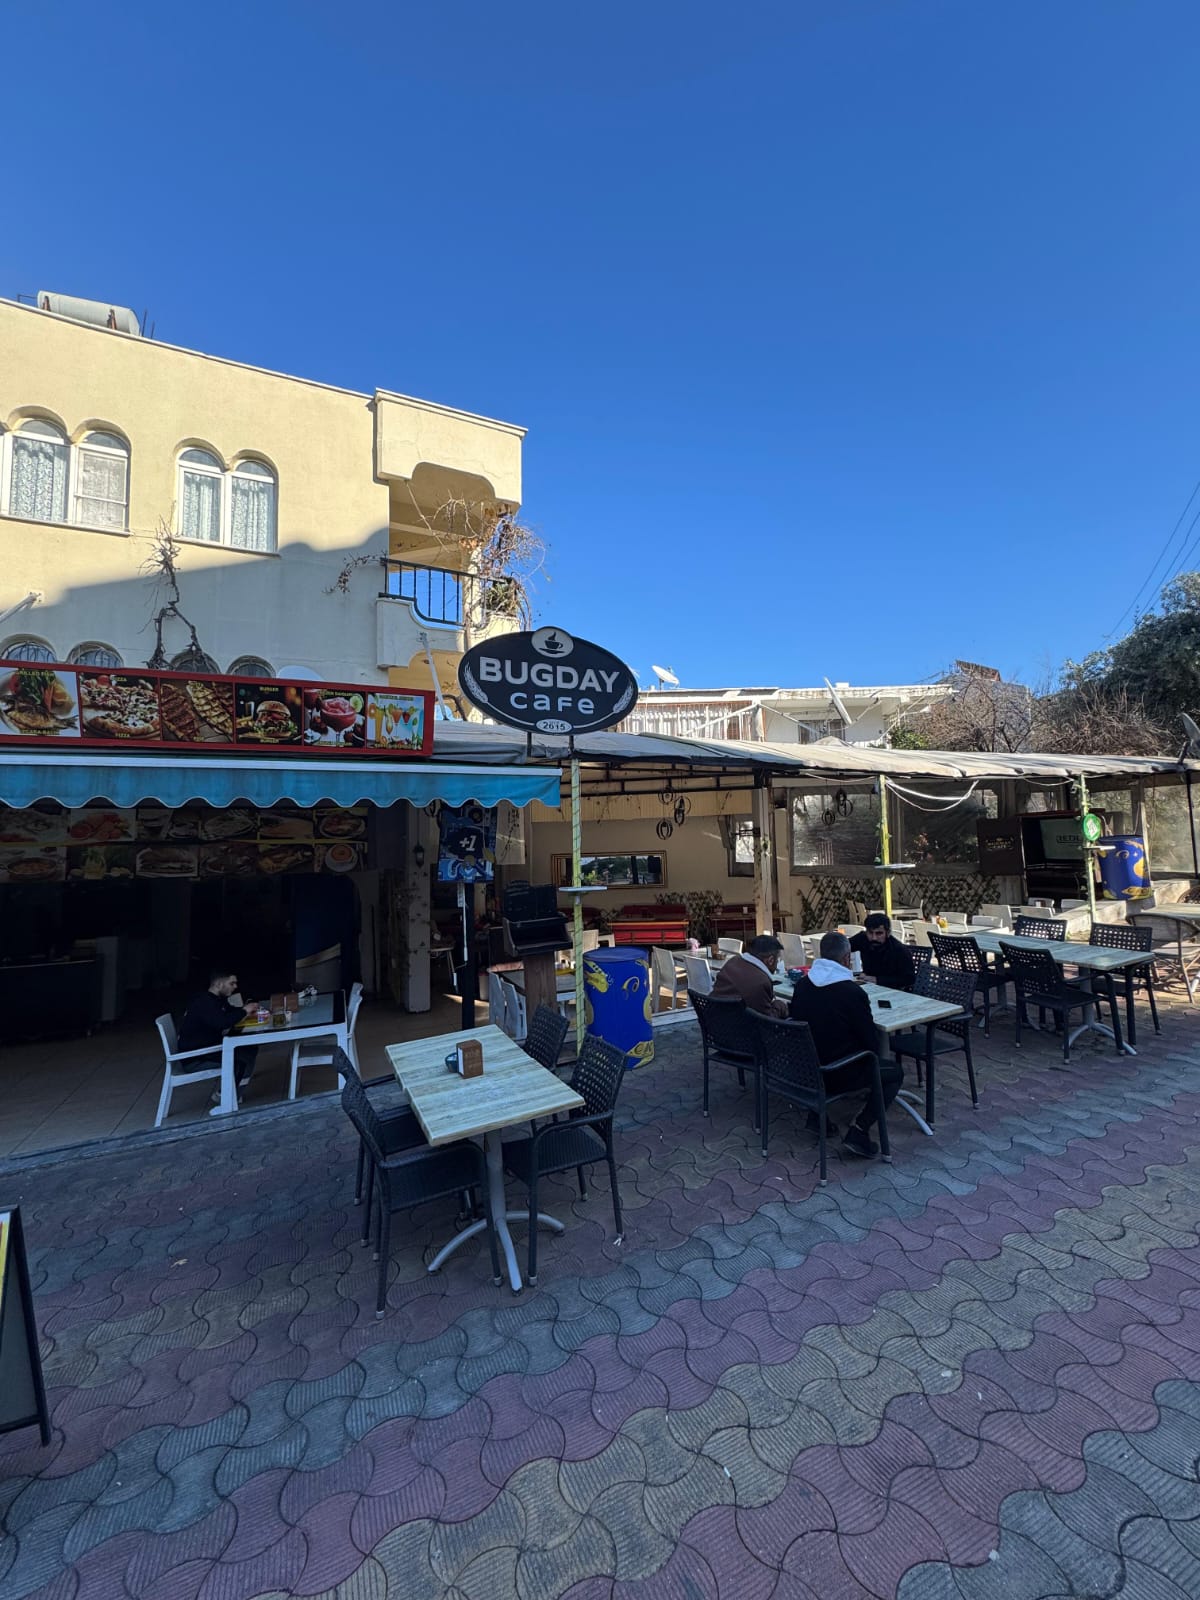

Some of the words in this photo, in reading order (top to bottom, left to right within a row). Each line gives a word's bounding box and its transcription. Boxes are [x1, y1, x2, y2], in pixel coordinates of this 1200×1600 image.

[479, 656, 620, 693] BUGDAY
[543, 721, 566, 731] 2015
[459, 835, 477, 852] +1
